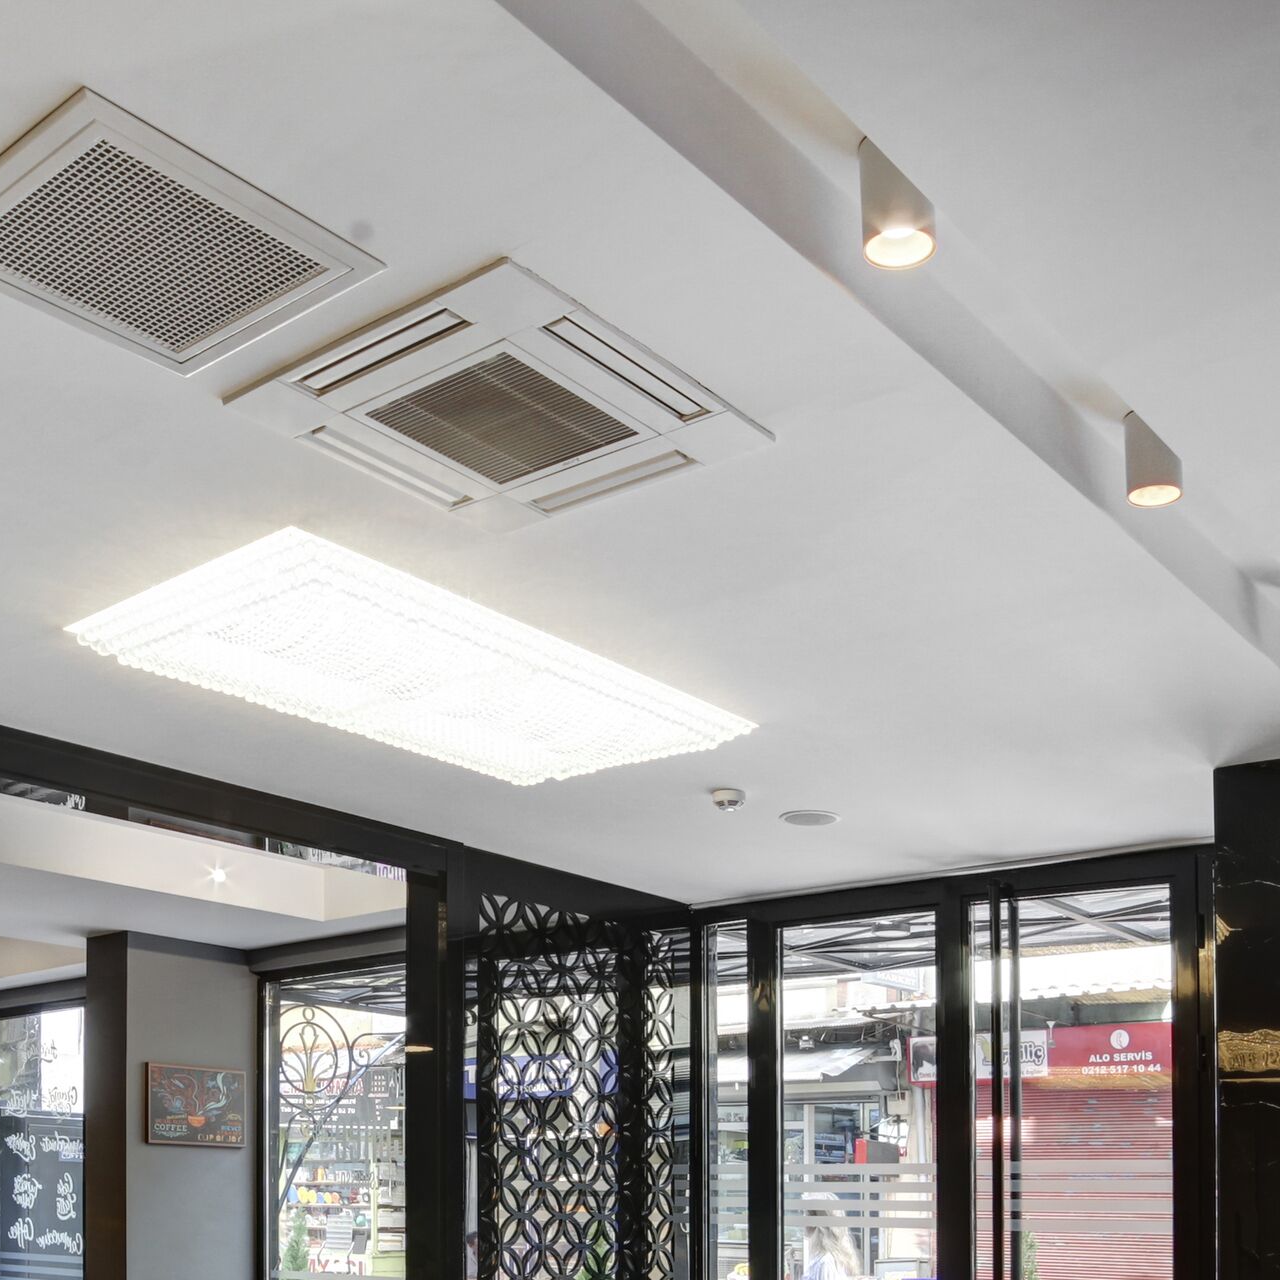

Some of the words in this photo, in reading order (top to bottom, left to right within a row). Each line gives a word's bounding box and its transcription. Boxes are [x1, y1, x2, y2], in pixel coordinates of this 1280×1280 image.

[1088, 1053, 1110, 1062] ALO
[1112, 1051, 1153, 1062] SERVİS
[1081, 1065, 1108, 1075] 0212
[1109, 1065, 1129, 1074] 517
[1147, 1063, 1161, 1073] 44
